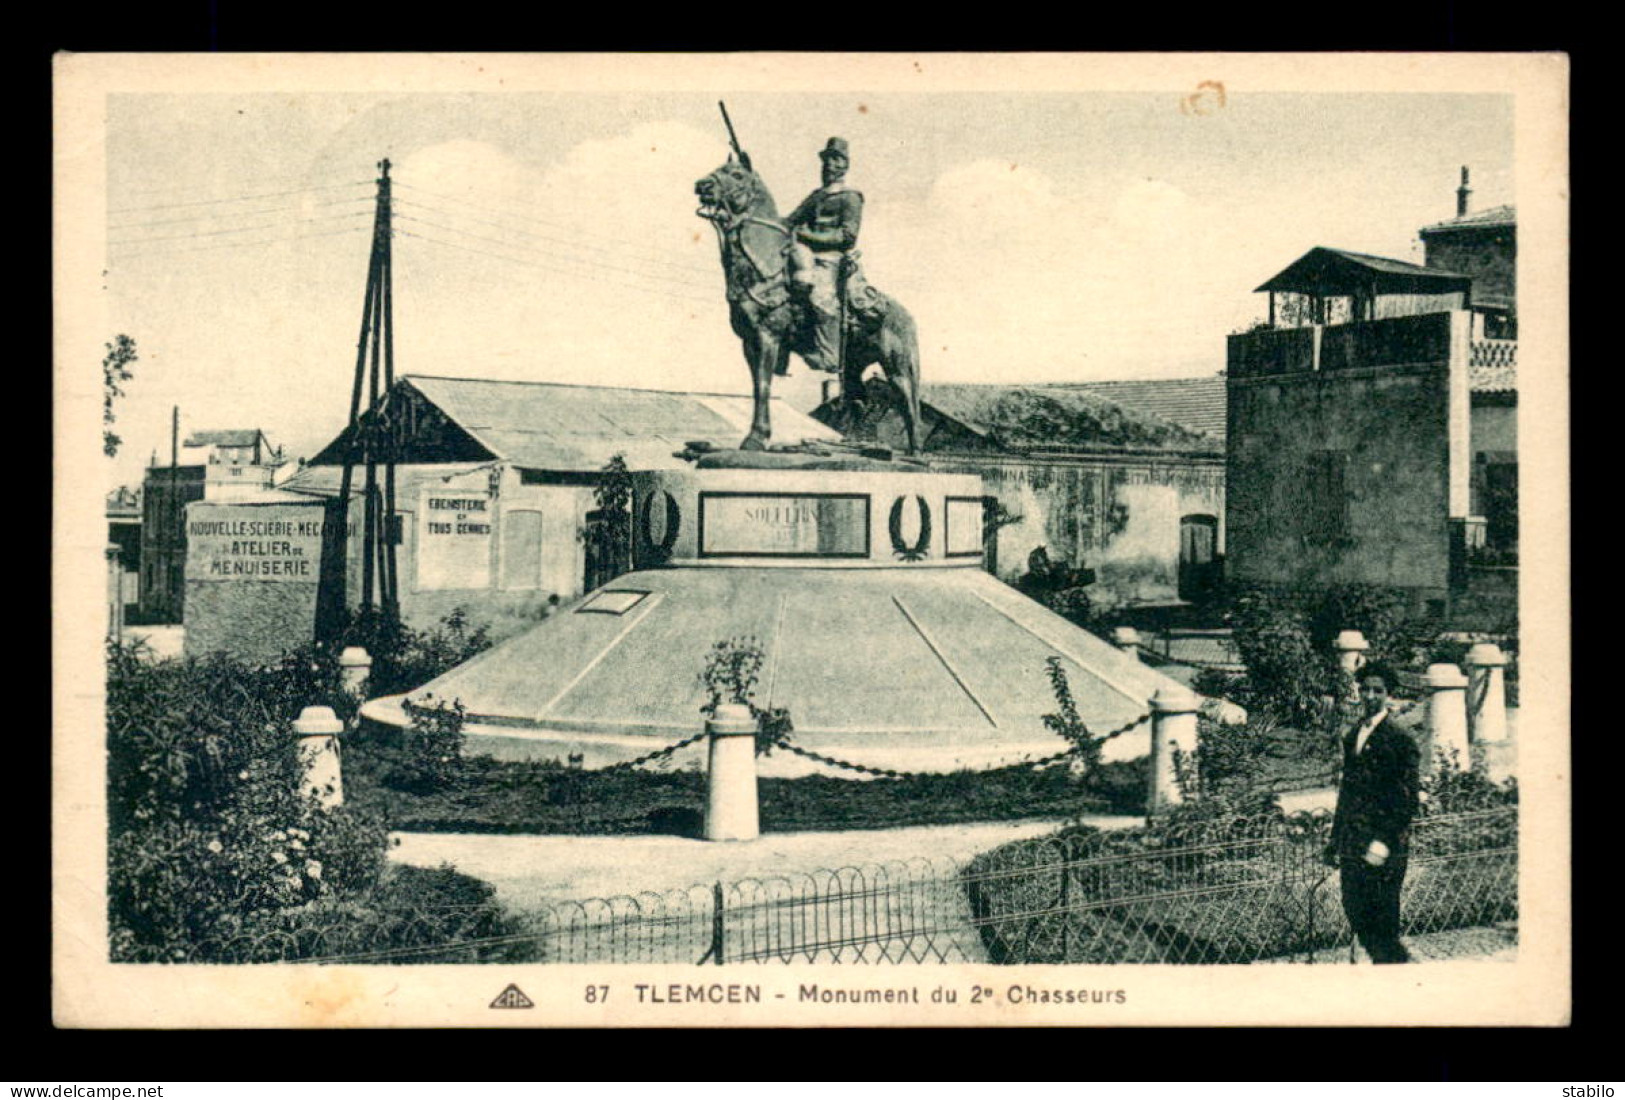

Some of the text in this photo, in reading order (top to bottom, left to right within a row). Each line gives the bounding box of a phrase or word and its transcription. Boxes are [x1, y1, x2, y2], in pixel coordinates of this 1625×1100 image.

[428, 522, 451, 535] TOUS
[232, 541, 290, 556] ATELIER
[211, 560, 310, 576] MENUISERIE
